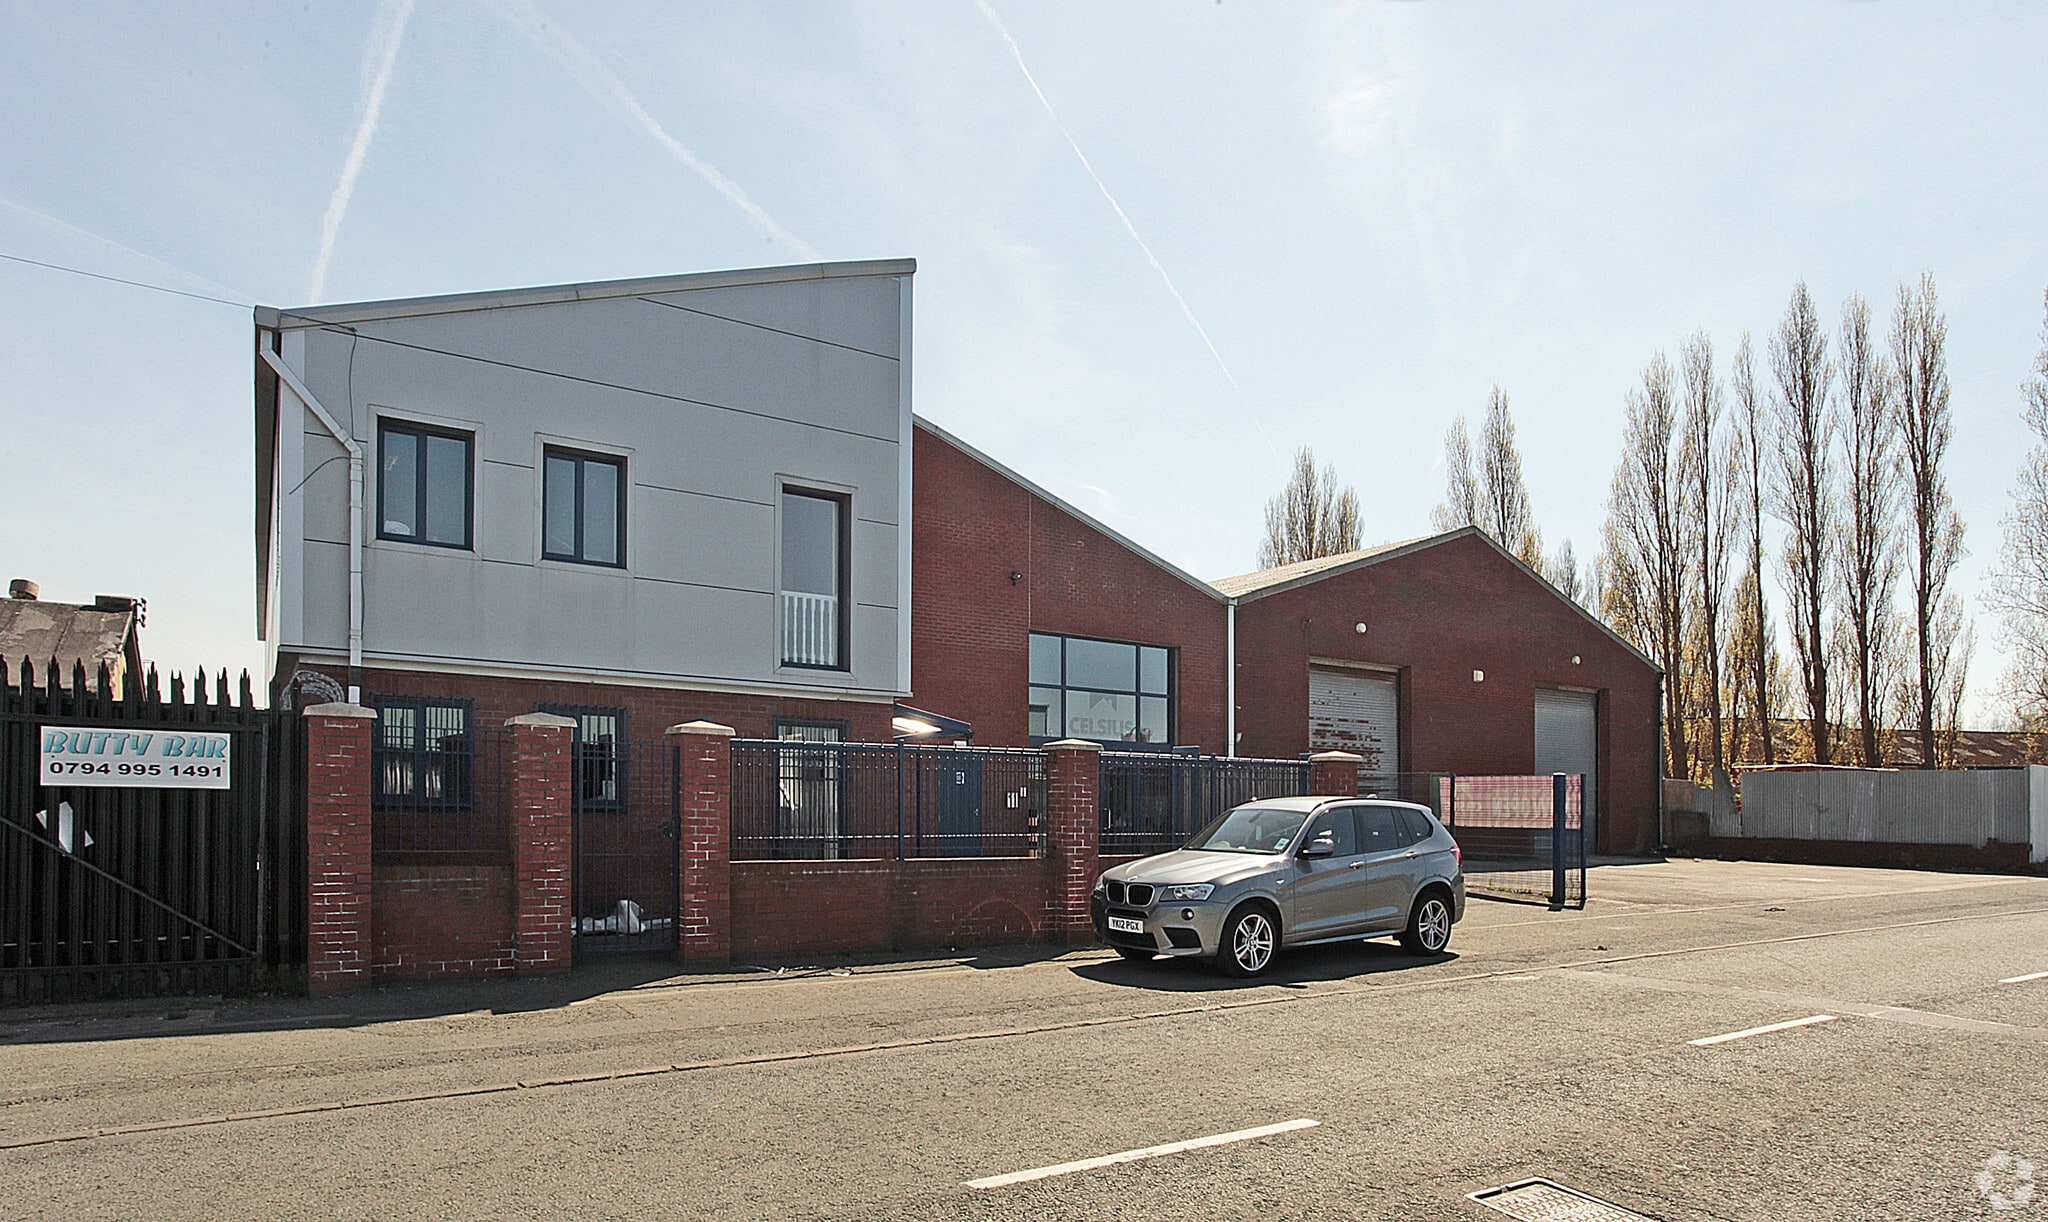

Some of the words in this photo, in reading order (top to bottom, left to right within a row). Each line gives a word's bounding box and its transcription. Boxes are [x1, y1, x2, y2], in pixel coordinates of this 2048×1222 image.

[43, 731, 153, 755] BUTTY
[162, 735, 227, 758] BAR
[49, 762, 111, 775] 0794
[117, 763, 161, 776] 995
[169, 765, 222, 777] 1491
[1126, 921, 1140, 931] PGX
